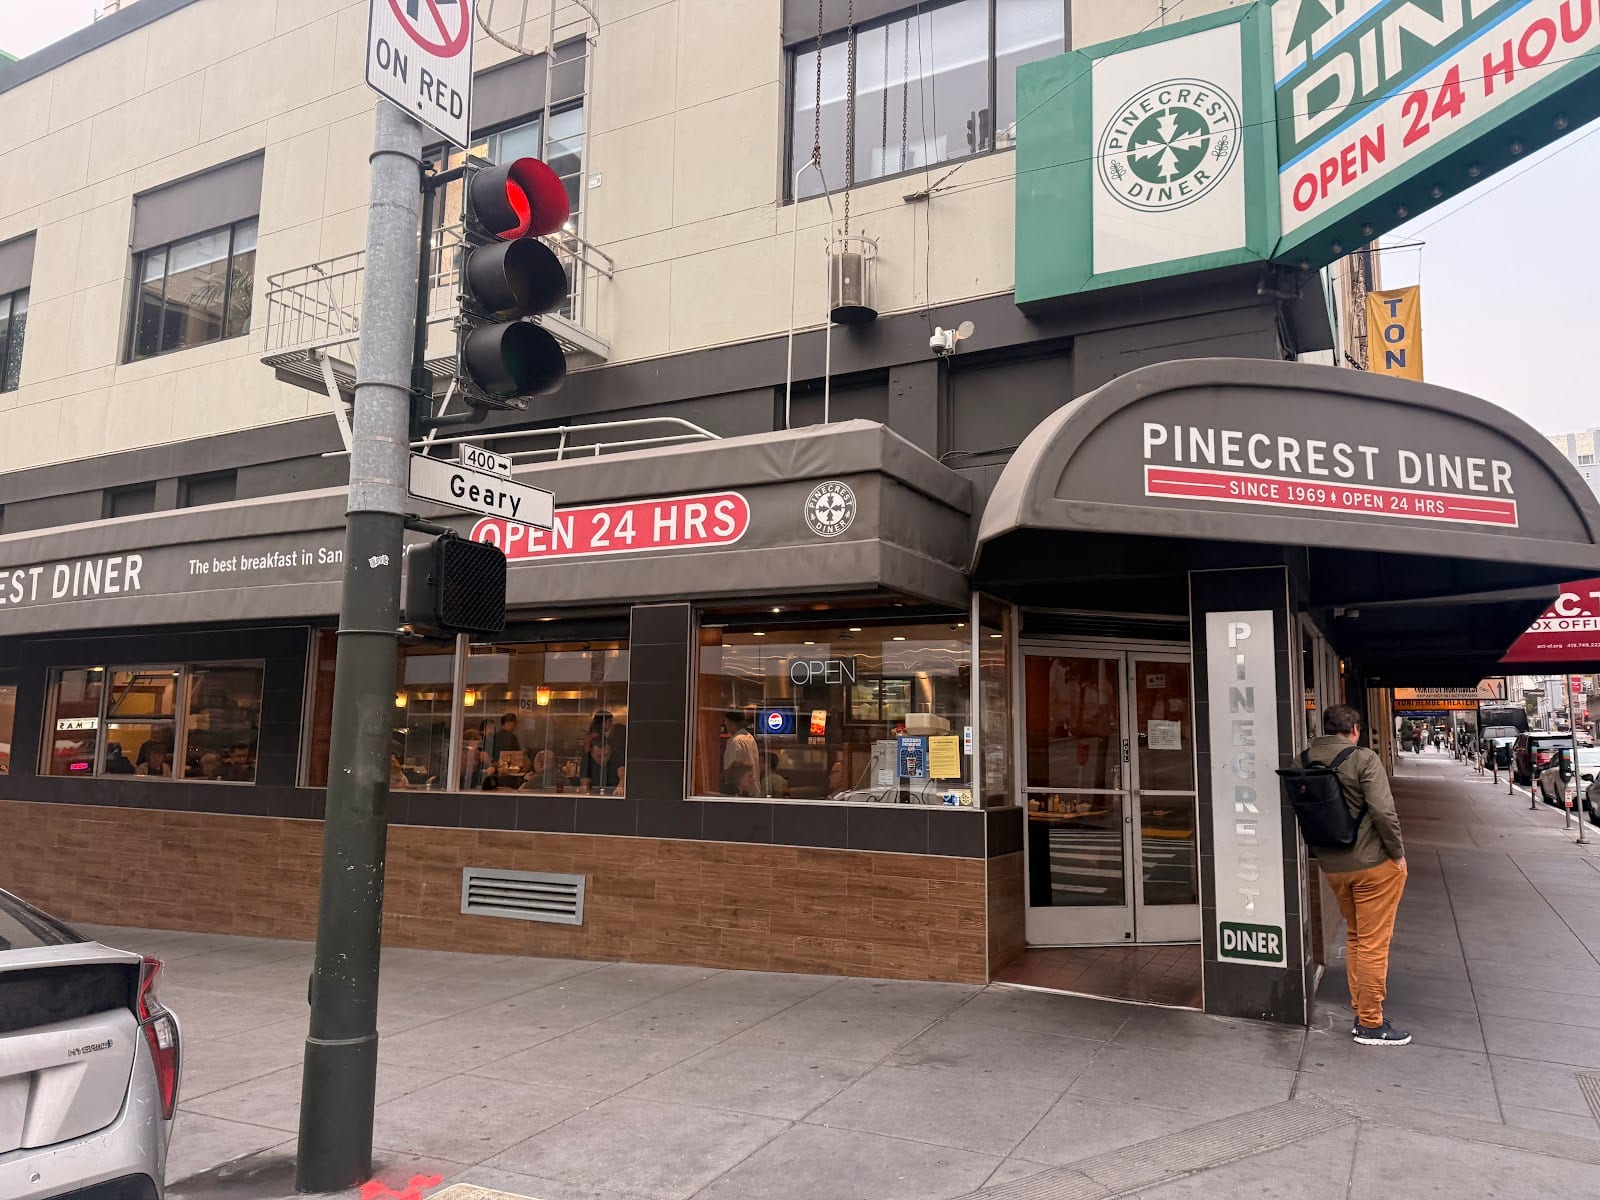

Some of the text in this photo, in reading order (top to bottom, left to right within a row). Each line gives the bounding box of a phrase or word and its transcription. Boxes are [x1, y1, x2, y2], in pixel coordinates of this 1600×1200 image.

[376, 37, 463, 120] ON RED
[1293, 0, 1498, 144] DIN
[1109, 89, 1229, 149] PINECREST
[1293, 0, 1600, 212] OPEN 24 HOU
[1127, 170, 1211, 201] DINER
[467, 450, 495, 470] 400
[1143, 423, 1514, 494] PINECREST DINER
[450, 474, 521, 517] Geary
[809, 485, 852, 508] PINECREST
[1229, 481, 1446, 514] SINCE 1969 OPEN 24 HRS
[479, 500, 736, 554] OPEN 24 HRS
[815, 520, 847, 533] DINER
[52, 554, 143, 599] DINER
[189, 547, 343, 575] The best breakfast in San
[1530, 620, 1552, 631] OX
[790, 659, 856, 686] OPEN
[1227, 622, 1261, 915] PINECREST
[1223, 928, 1281, 955] DINER
